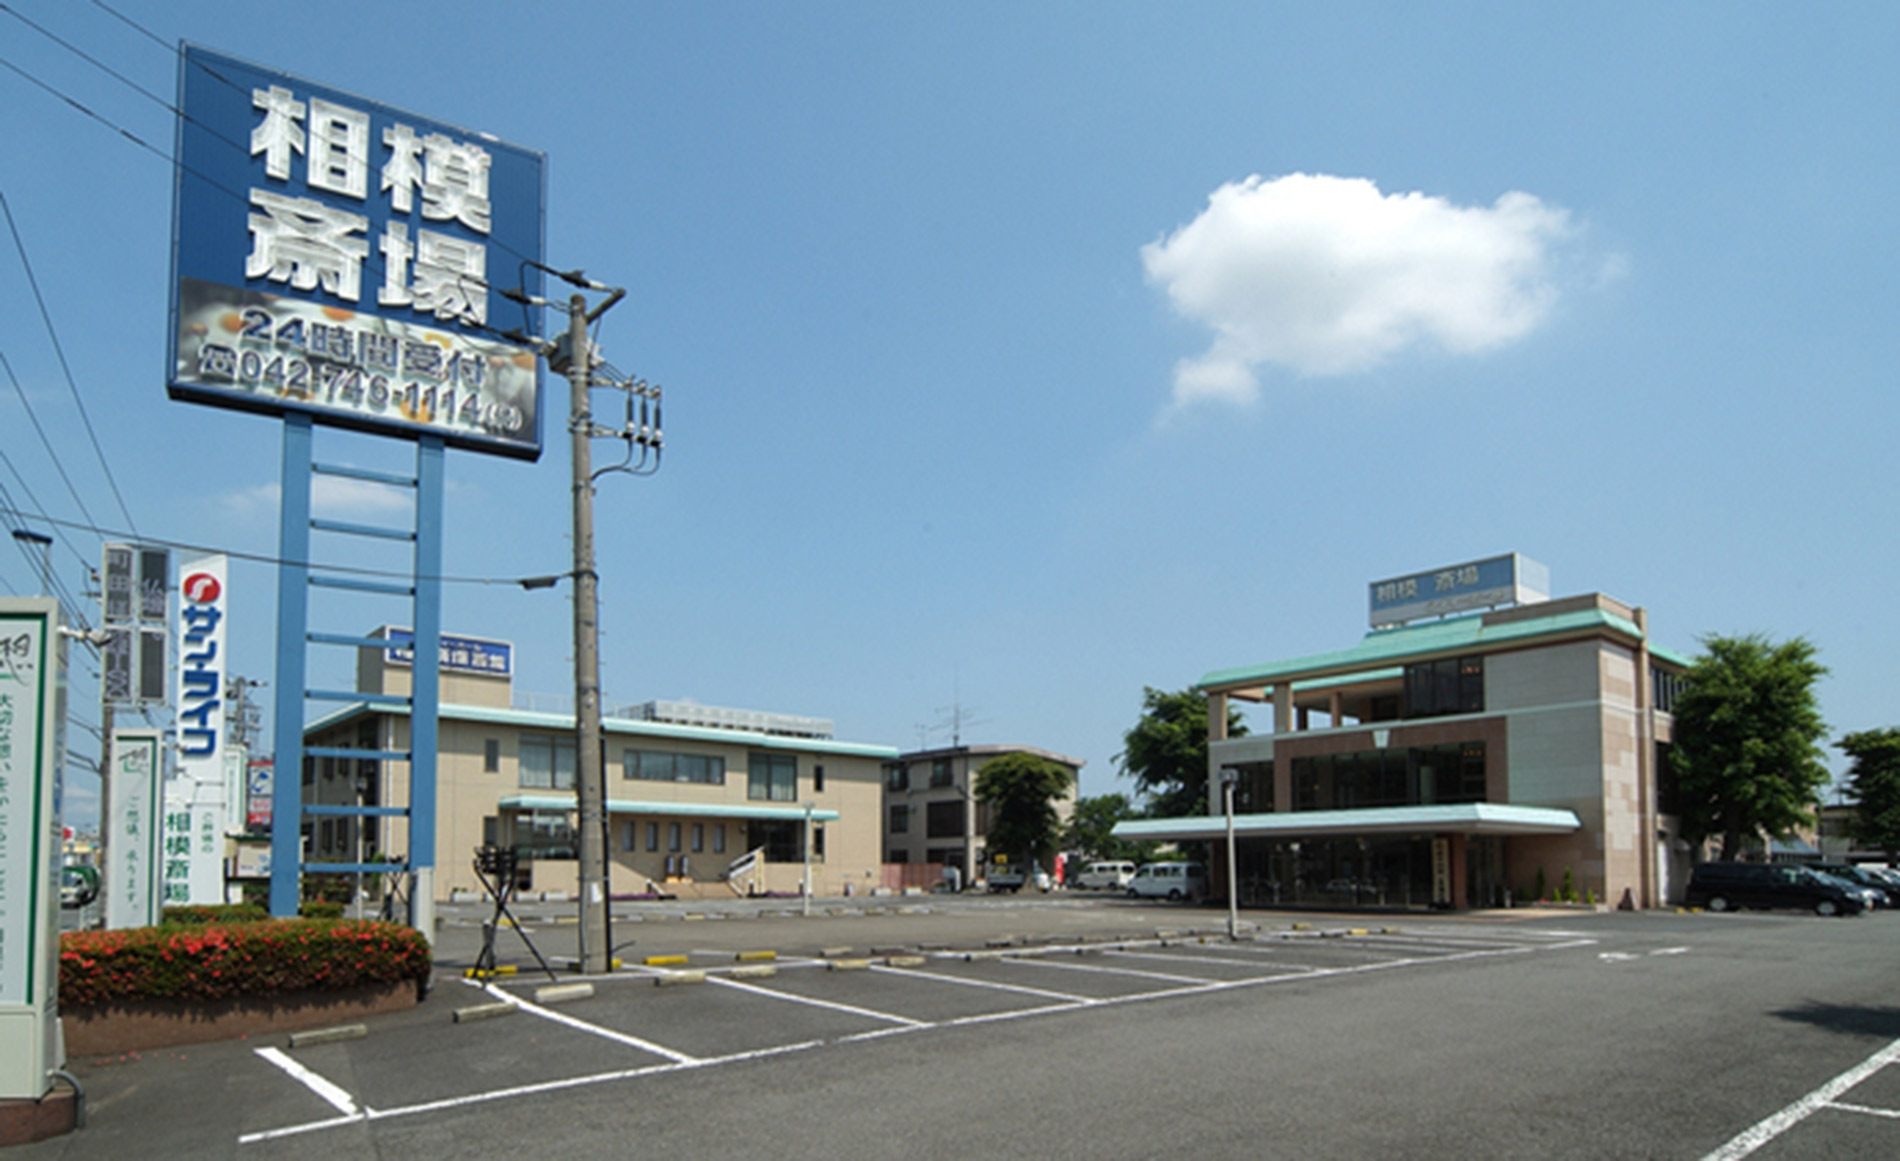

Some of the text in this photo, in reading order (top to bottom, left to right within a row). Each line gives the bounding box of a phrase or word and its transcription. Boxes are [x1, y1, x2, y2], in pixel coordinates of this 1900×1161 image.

[250, 85, 492, 234] 相模
[245, 187, 488, 326] 斎場
[240, 307, 487, 388] 24時間受付
[164, 811, 192, 903] 相模斎場
